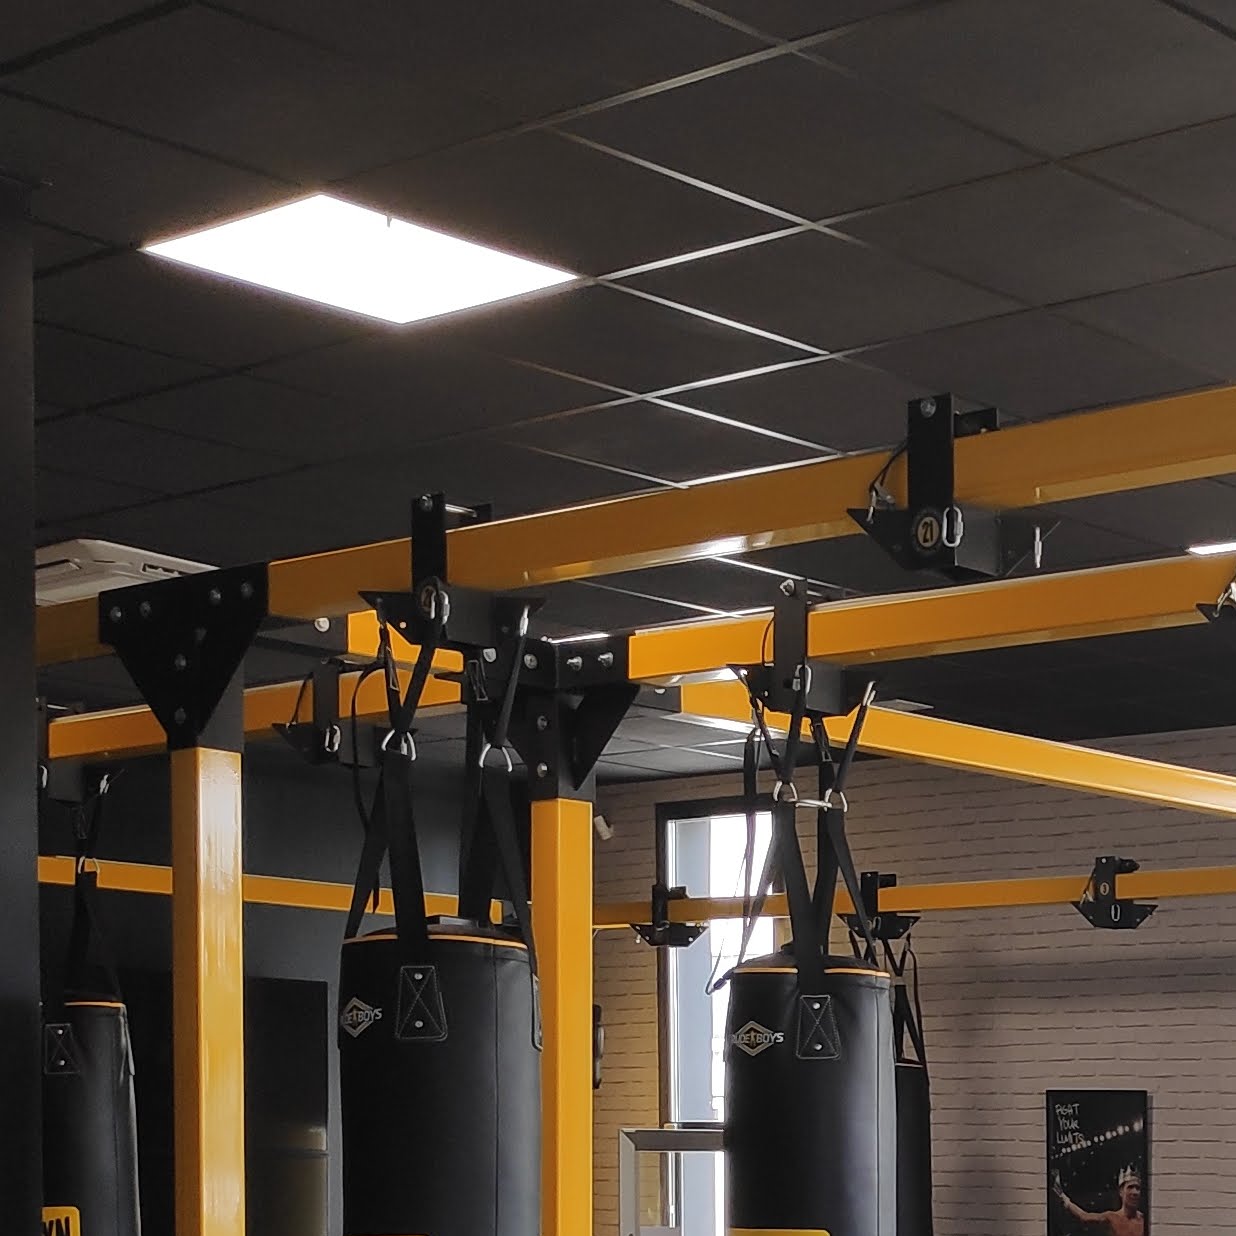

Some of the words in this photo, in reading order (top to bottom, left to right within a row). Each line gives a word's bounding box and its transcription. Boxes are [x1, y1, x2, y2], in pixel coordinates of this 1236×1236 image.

[922, 520, 934, 543] 21
[357, 1008, 383, 1022] BOYS
[756, 1032, 785, 1044] BOYS
